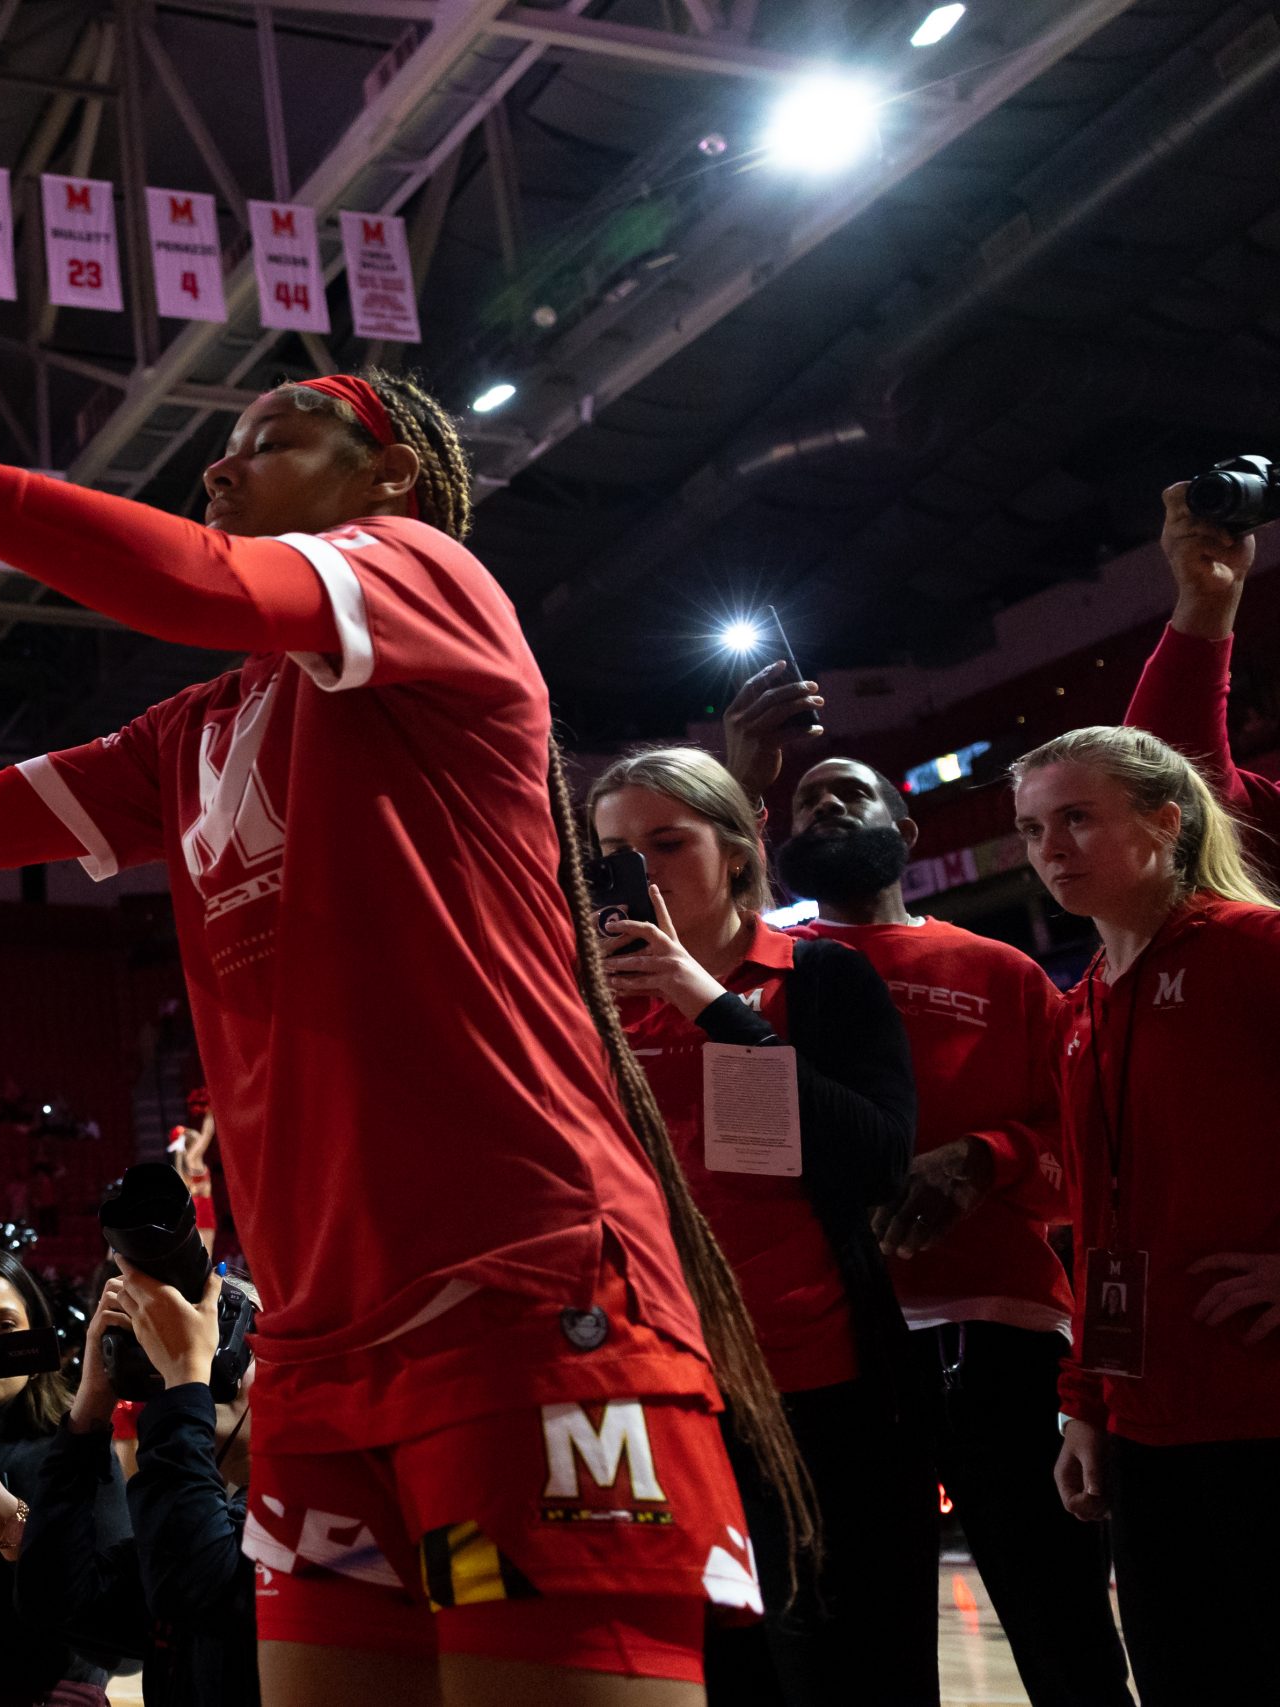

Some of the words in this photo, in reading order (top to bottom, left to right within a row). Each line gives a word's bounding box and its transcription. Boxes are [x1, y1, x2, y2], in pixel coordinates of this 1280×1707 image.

[65, 183, 92, 215] M
[169, 196, 195, 225] M
[271, 208, 296, 238] M
[362, 219, 385, 247] M
[67, 258, 102, 290] 23
[180, 271, 199, 301] 4
[275, 281, 309, 313] 44
[886, 979, 992, 1016] FFECT
[1152, 968, 1187, 1005] M
[541, 1397, 667, 1503] M
